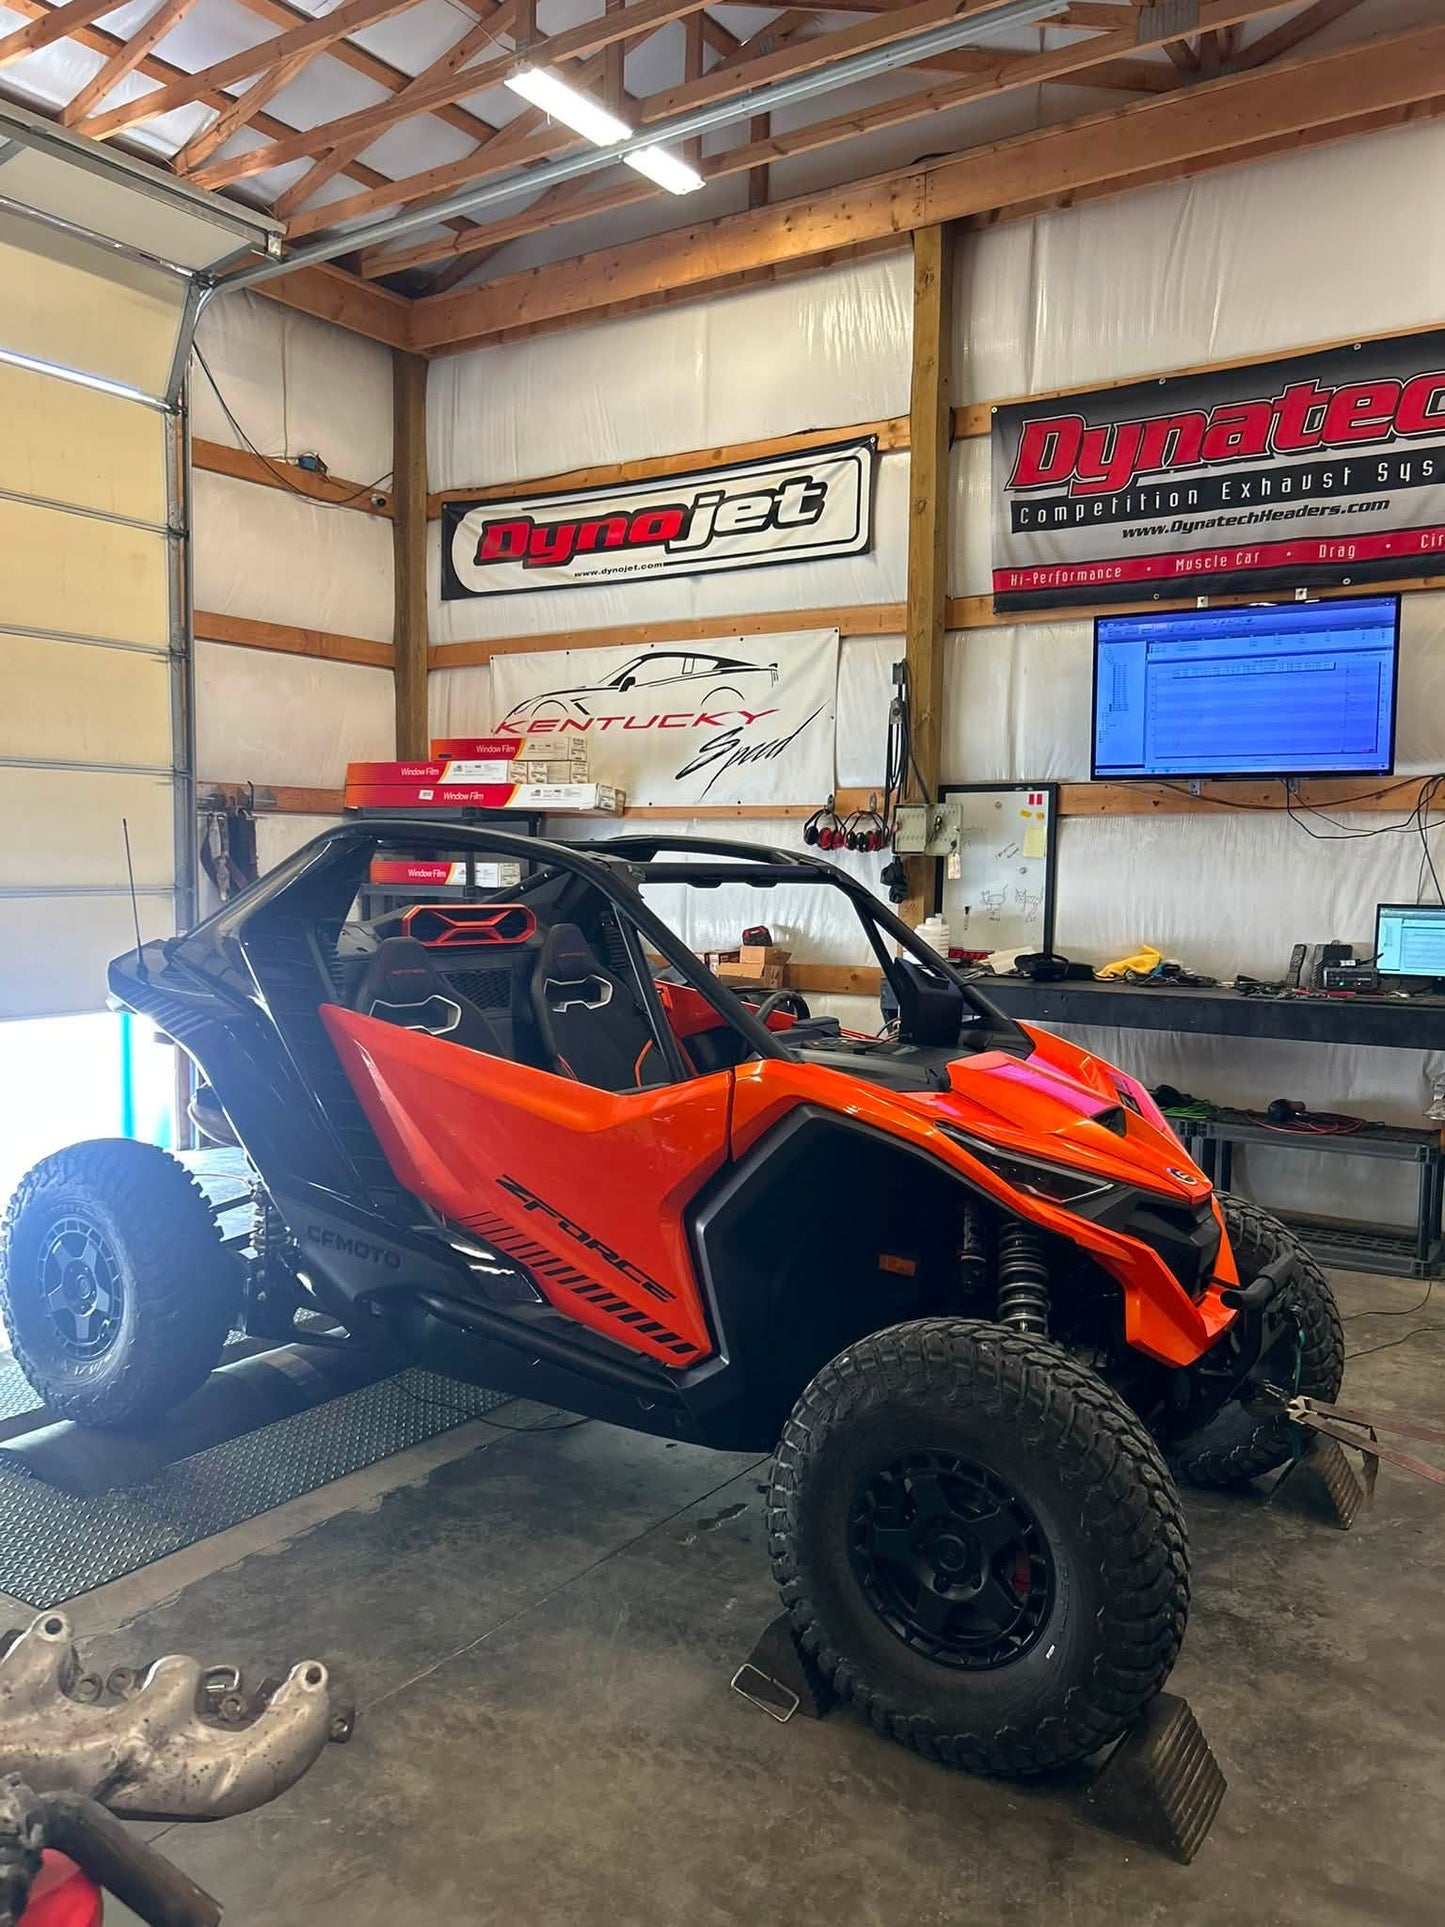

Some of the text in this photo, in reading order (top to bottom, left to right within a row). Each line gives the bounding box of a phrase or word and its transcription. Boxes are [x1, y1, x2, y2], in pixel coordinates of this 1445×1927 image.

[1020, 460, 1434, 524] Competition Exhaust Sys
[474, 475, 827, 569] Dynojet
[1122, 500, 1390, 540] www.DynatechHeaders.com
[574, 562, 664, 577] www.dynojet.com
[1010, 566, 1122, 586] Hi-Performance
[1175, 554, 1227, 572] Muscle
[1236, 551, 1259, 566] Car
[1319, 544, 1356, 560] Drag
[494, 708, 782, 735] KENTUCKY
[476, 744, 516, 753] Window Film
[674, 700, 830, 802] Speed
[401, 767, 439, 776] Window Film
[443, 791, 484, 801] Window Film
[408, 868, 447, 878] Window Film
[495, 1174, 677, 1303] ZFORCE
